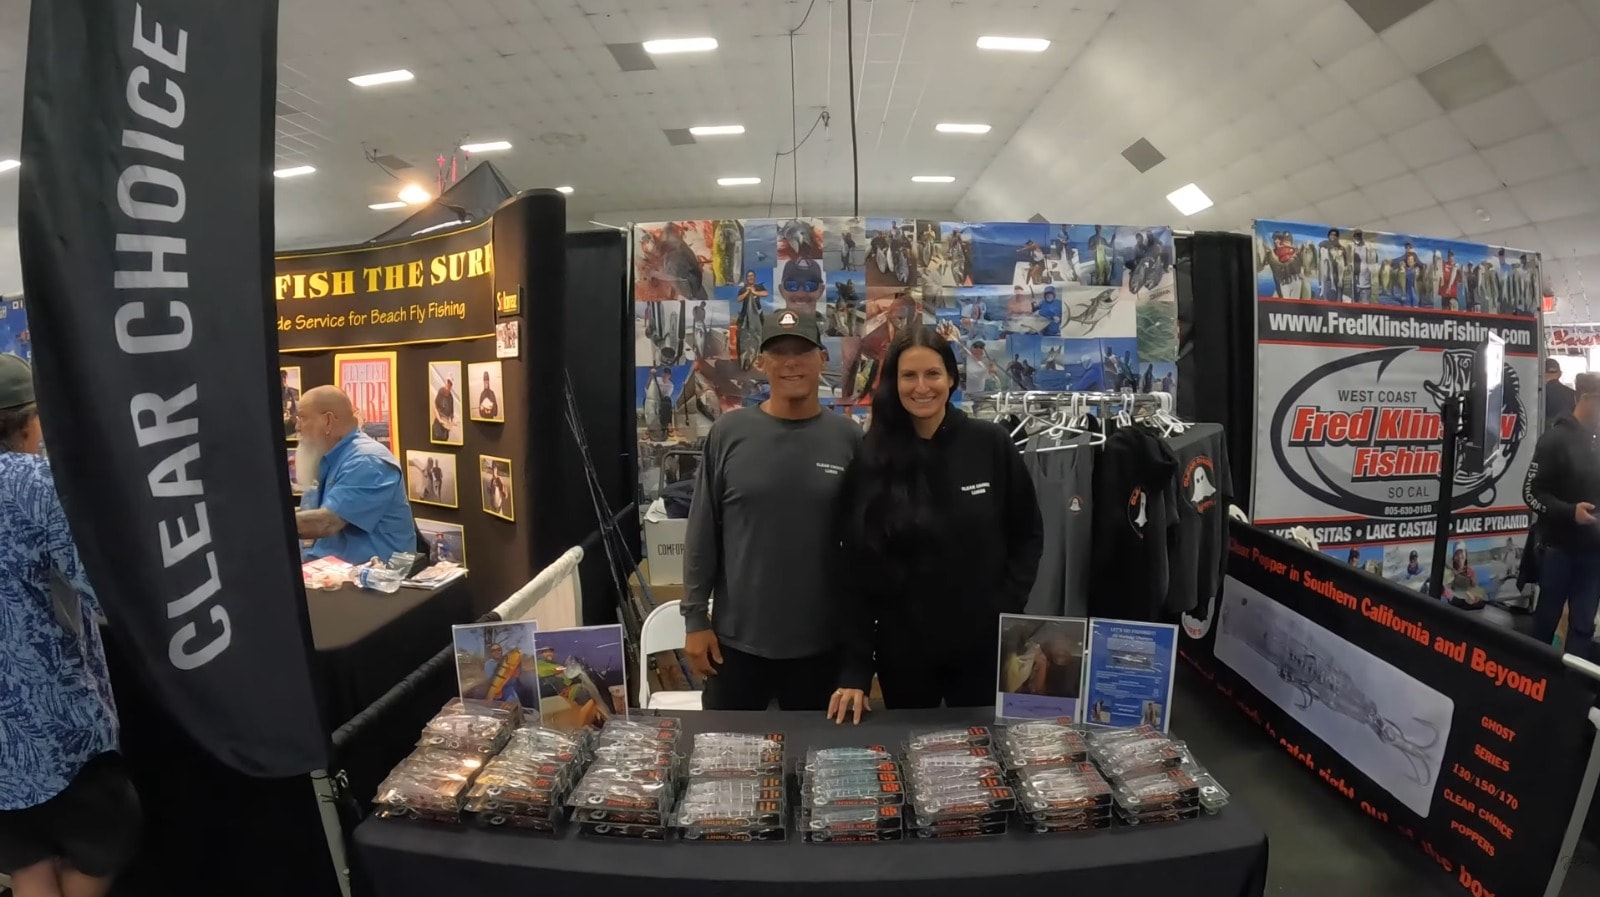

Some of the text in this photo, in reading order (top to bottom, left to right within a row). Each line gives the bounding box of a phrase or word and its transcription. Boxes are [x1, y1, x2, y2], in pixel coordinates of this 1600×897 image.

[275, 269, 355, 300] FISH
[363, 260, 423, 293] THE
[295, 311, 345, 330] Service
[348, 310, 367, 326] for
[371, 306, 406, 324] Beach
[410, 304, 426, 323] Fly
[428, 301, 466, 320] Fishing
[1268, 311, 1531, 346] www.FredKlinshawFishincom
[114, 3, 232, 670] CLEAR CHOICE
[1338, 390, 1417, 404] WEST COAST
[1290, 406, 1375, 442] Fred
[1353, 446, 1442, 478] Fishin
[1388, 486, 1429, 498] SO CAL
[1309, 526, 1352, 543] ASITAS
[1366, 523, 1396, 540] LAKE
[1399, 520, 1437, 538] CASTAI
[1456, 517, 1482, 533] LAKE
[1484, 514, 1529, 531] PYRAMID
[1252, 547, 1288, 575] Popper
[1289, 564, 1300, 582] in
[1303, 570, 1358, 611] Southern
[1361, 597, 1430, 646] California
[1434, 636, 1467, 663] and
[1470, 647, 1547, 702] Beyond
[1481, 716, 1516, 742] GHOST
[1473, 743, 1510, 772] SERIES
[1453, 763, 1519, 810] 130/150/170
[1443, 788, 1514, 840] CLEAR CHOICE
[1451, 820, 1495, 857] POPPERS
